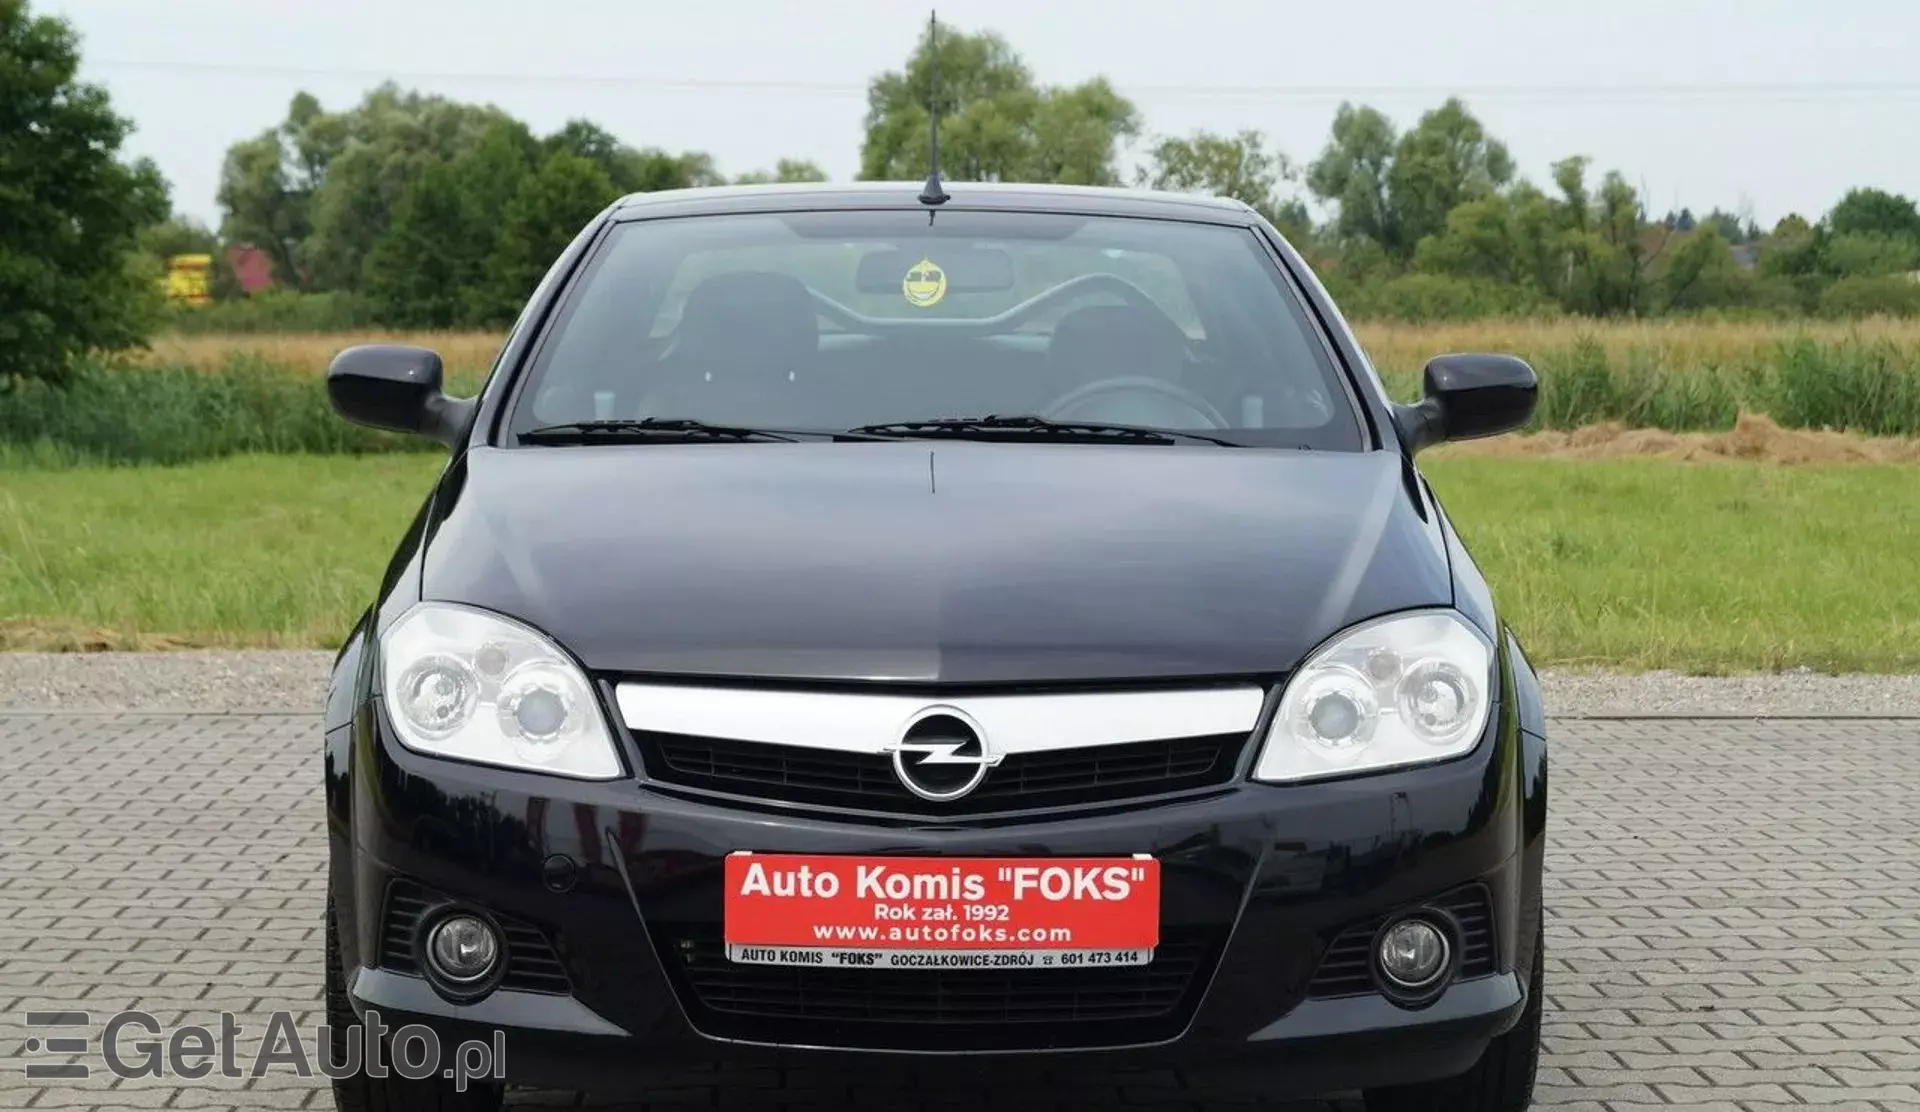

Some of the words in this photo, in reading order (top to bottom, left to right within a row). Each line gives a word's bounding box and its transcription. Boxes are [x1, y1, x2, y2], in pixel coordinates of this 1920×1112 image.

[740, 862, 840, 897] Auto
[856, 865, 985, 900] Komis
[998, 867, 1145, 901] "FOKS"
[874, 903, 917, 920] Rok
[922, 903, 958, 920] zał.
[963, 905, 1010, 922] 1992
[812, 924, 1072, 942] www.autofoks.com
[741, 947, 777, 962] AUTO
[780, 948, 824, 964] KOMIS
[890, 952, 1035, 967] GOCZAŁKOWICE-ZDRÓJ
[1061, 951, 1084, 965] 601
[1087, 950, 1111, 964] 473
[1114, 950, 1139, 963] 414
